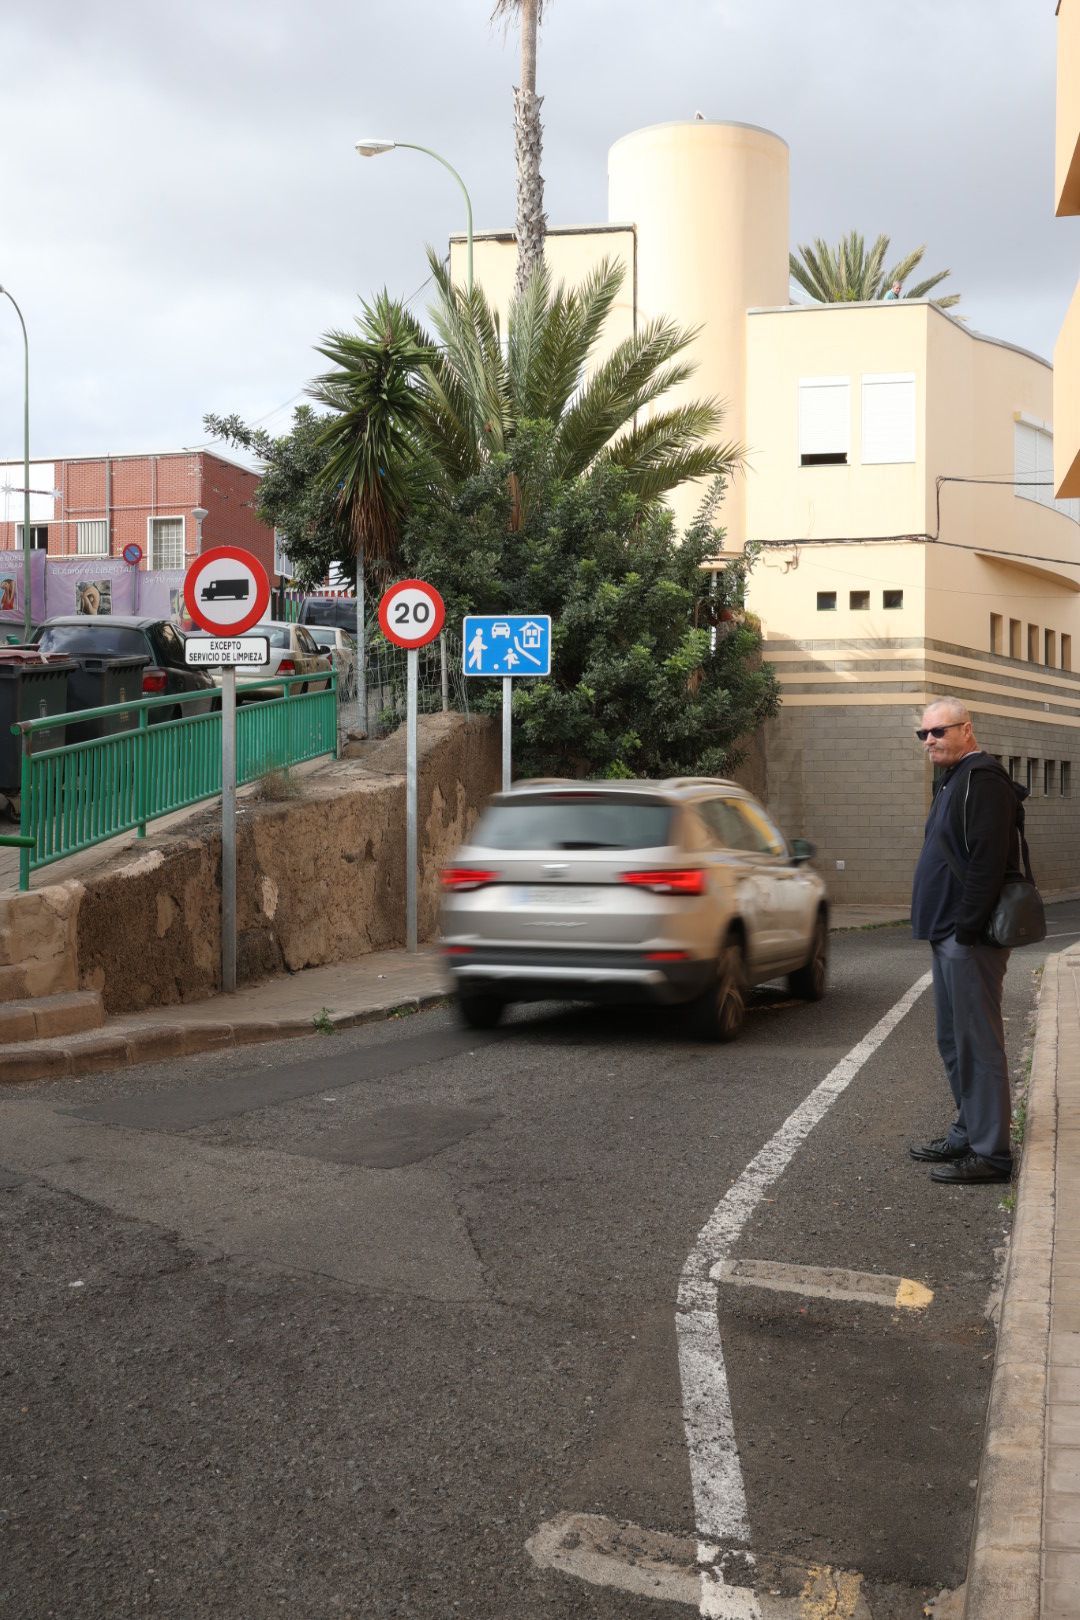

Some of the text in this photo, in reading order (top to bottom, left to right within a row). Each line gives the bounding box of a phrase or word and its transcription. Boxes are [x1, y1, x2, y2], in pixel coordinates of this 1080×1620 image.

[394, 602, 430, 624] 20
[210, 641, 242, 651] EXCEPTO
[189, 652, 263, 662] SERVICIO DE LIMPIEZA
